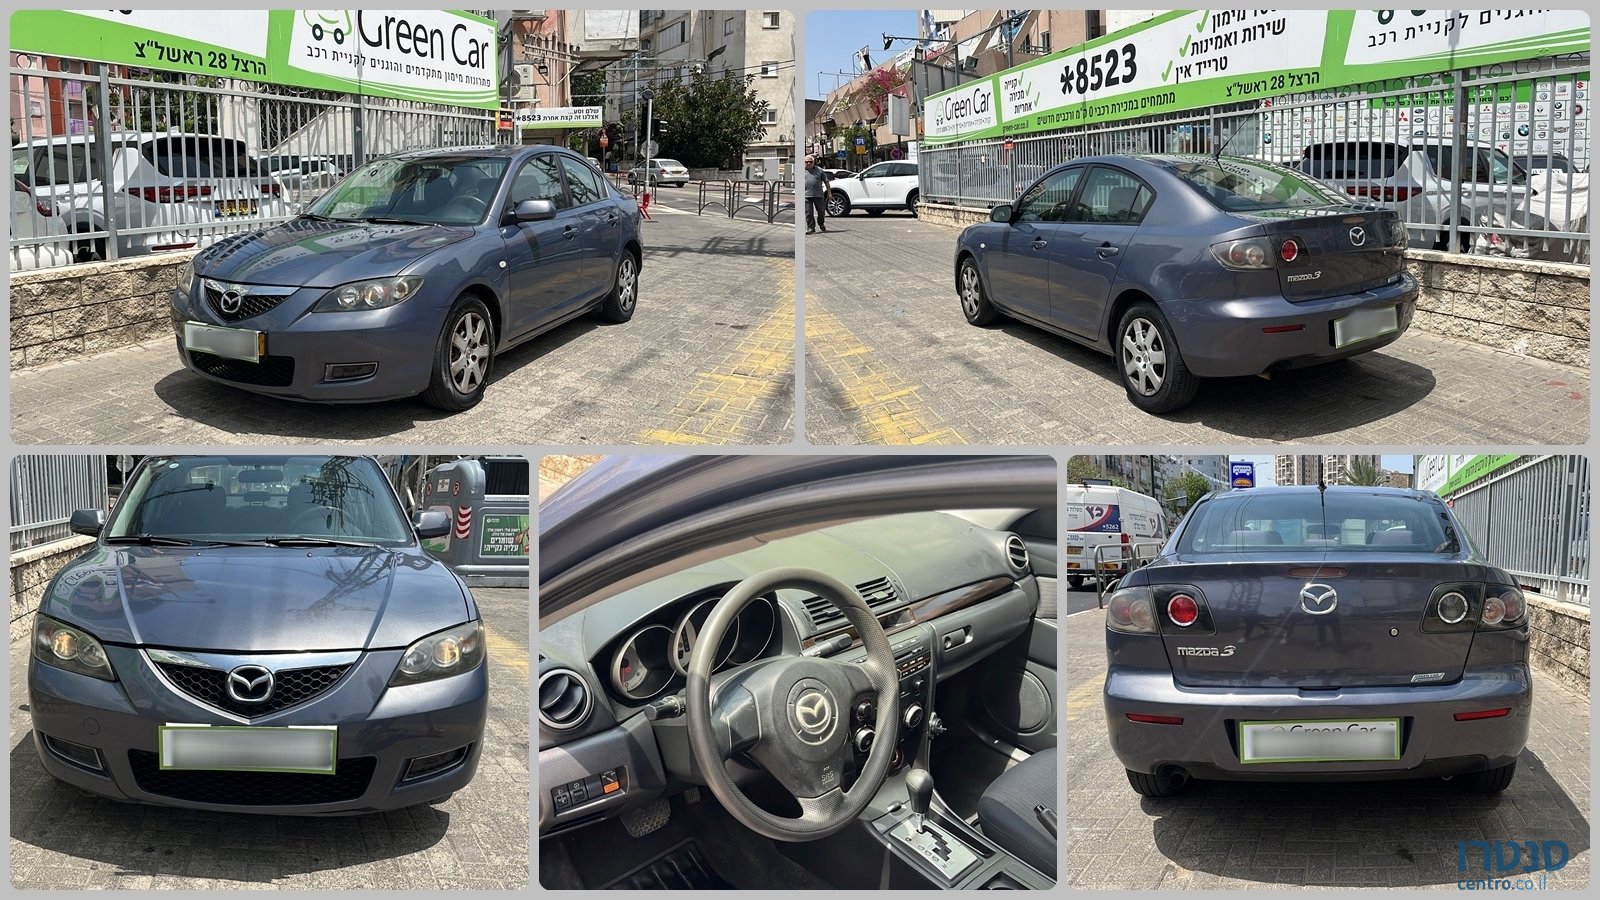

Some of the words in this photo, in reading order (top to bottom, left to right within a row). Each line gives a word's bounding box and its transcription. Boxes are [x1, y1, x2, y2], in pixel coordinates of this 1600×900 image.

[1212, 10, 1246, 33] מימון
[1404, 12, 1469, 41] לקניית
[1241, 17, 1286, 44] שירות
[1367, 30, 1397, 48] רכב
[451, 23, 489, 69] Car
[1190, 30, 1238, 57] ואמינות
[207, 51, 227, 70] 28
[306, 45, 328, 60] רכב
[331, 49, 366, 68] לקניית
[231, 54, 267, 76] הרצל
[370, 58, 403, 73] והוגנים
[405, 64, 442, 80] מתקדמים
[1175, 63, 1192, 84] אין
[1195, 56, 1228, 76] טרייד
[444, 71, 464, 84] מימון
[465, 74, 491, 88] פתרונות
[1004, 78, 1018, 91] קנייה
[1270, 75, 1285, 91] 28
[1288, 71, 1320, 88] הרצל
[945, 97, 972, 121] Green
[973, 88, 991, 115] Car
[1009, 90, 1025, 102] מכירה
[1141, 91, 1176, 109] מתמחים
[1014, 101, 1033, 115] אחריות
[1095, 105, 1110, 116] רכבי
[1111, 98, 1139, 114] במכירת
[1037, 114, 1055, 126] חדשים
[503, 544, 519, 552] עליה
